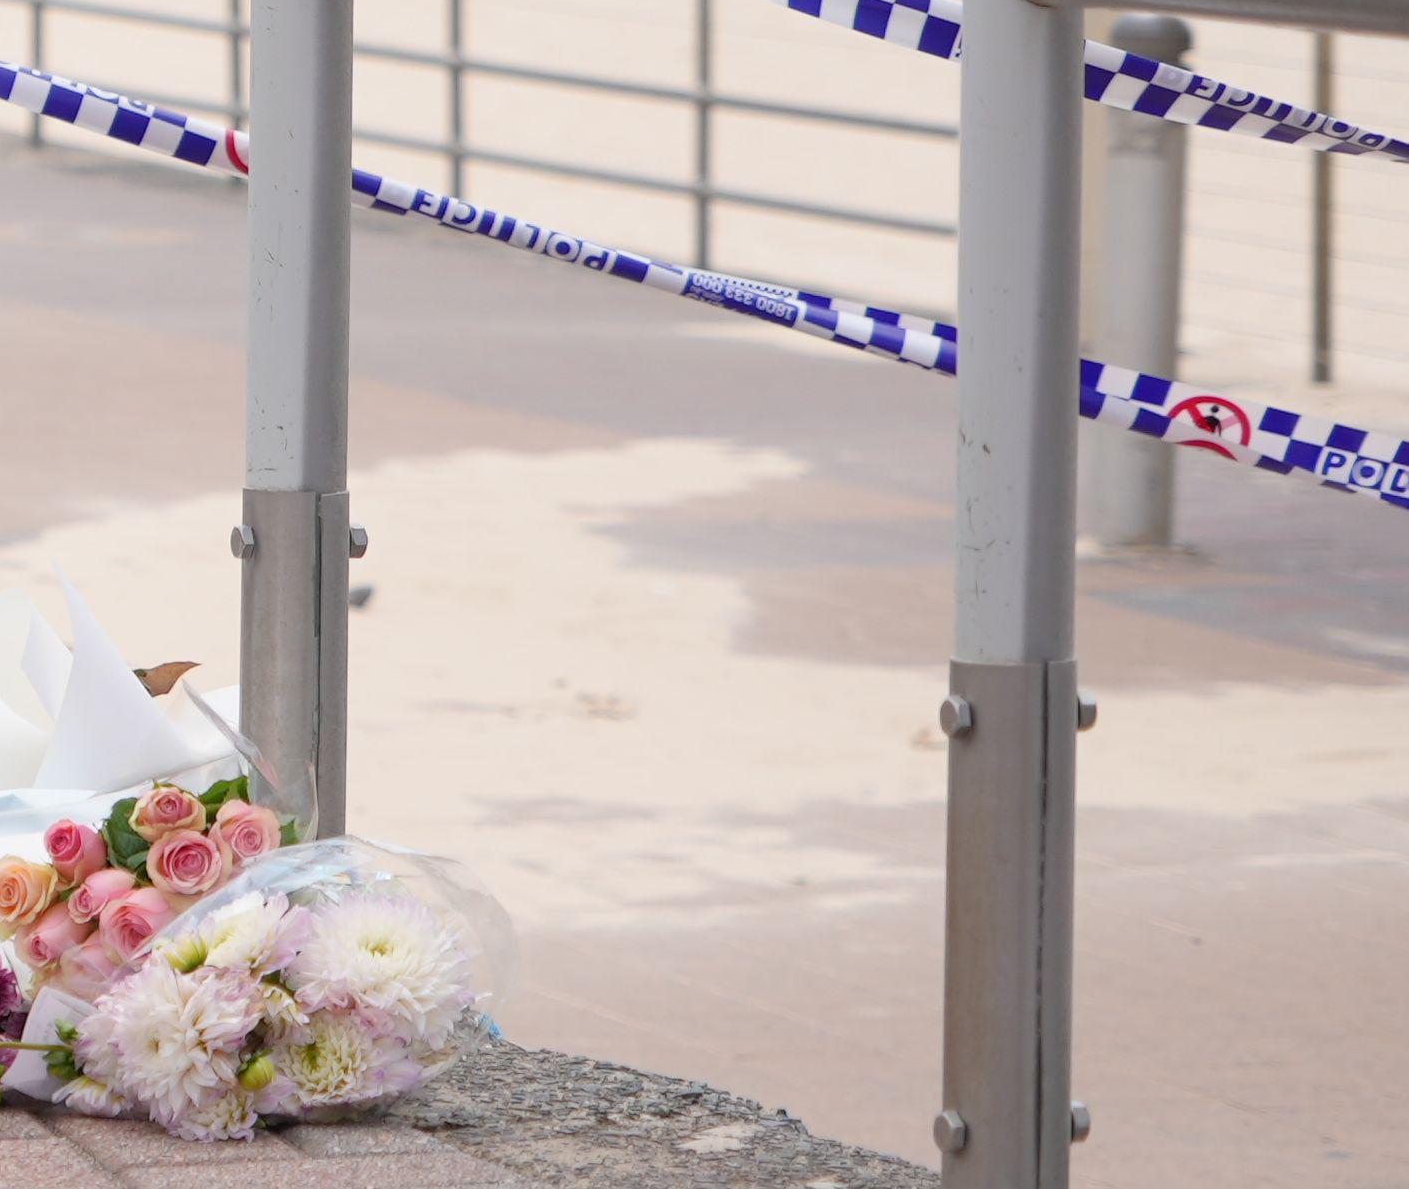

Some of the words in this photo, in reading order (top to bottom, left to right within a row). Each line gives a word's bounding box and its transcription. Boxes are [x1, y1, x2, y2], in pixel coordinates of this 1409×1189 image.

[419, 191, 609, 271] POLICE
[692, 274, 723, 294] 000
[755, 296, 795, 320] 1800
